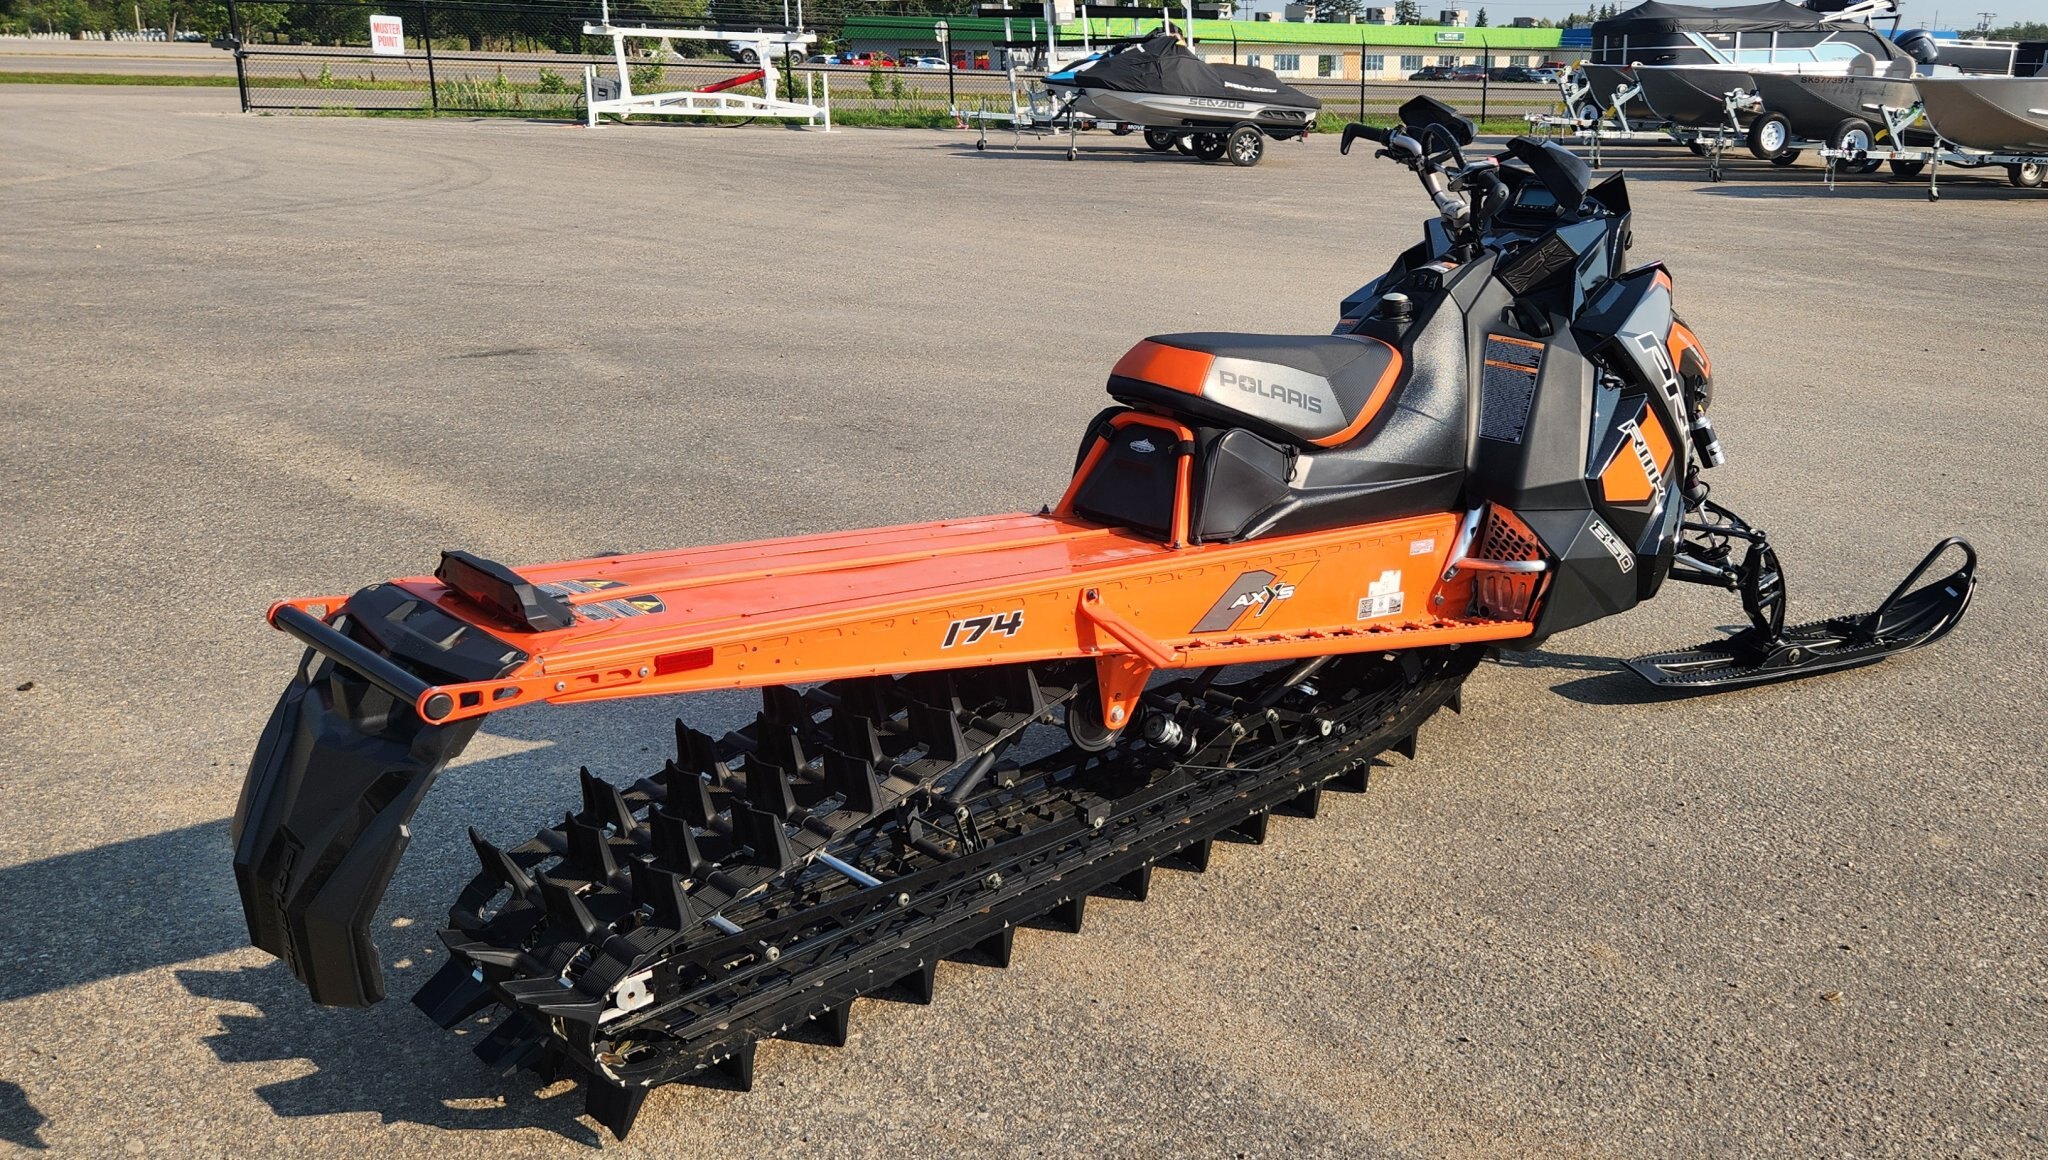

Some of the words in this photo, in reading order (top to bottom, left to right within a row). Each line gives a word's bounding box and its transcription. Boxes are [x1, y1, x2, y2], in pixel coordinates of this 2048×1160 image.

[373, 22, 401, 35] MUSTER
[377, 35, 399, 47] POINT
[1219, 370, 1322, 414] POLARIS
[1588, 519, 1635, 574] 850
[1227, 582, 1296, 618] AXYS
[940, 609, 1025, 650] 174
